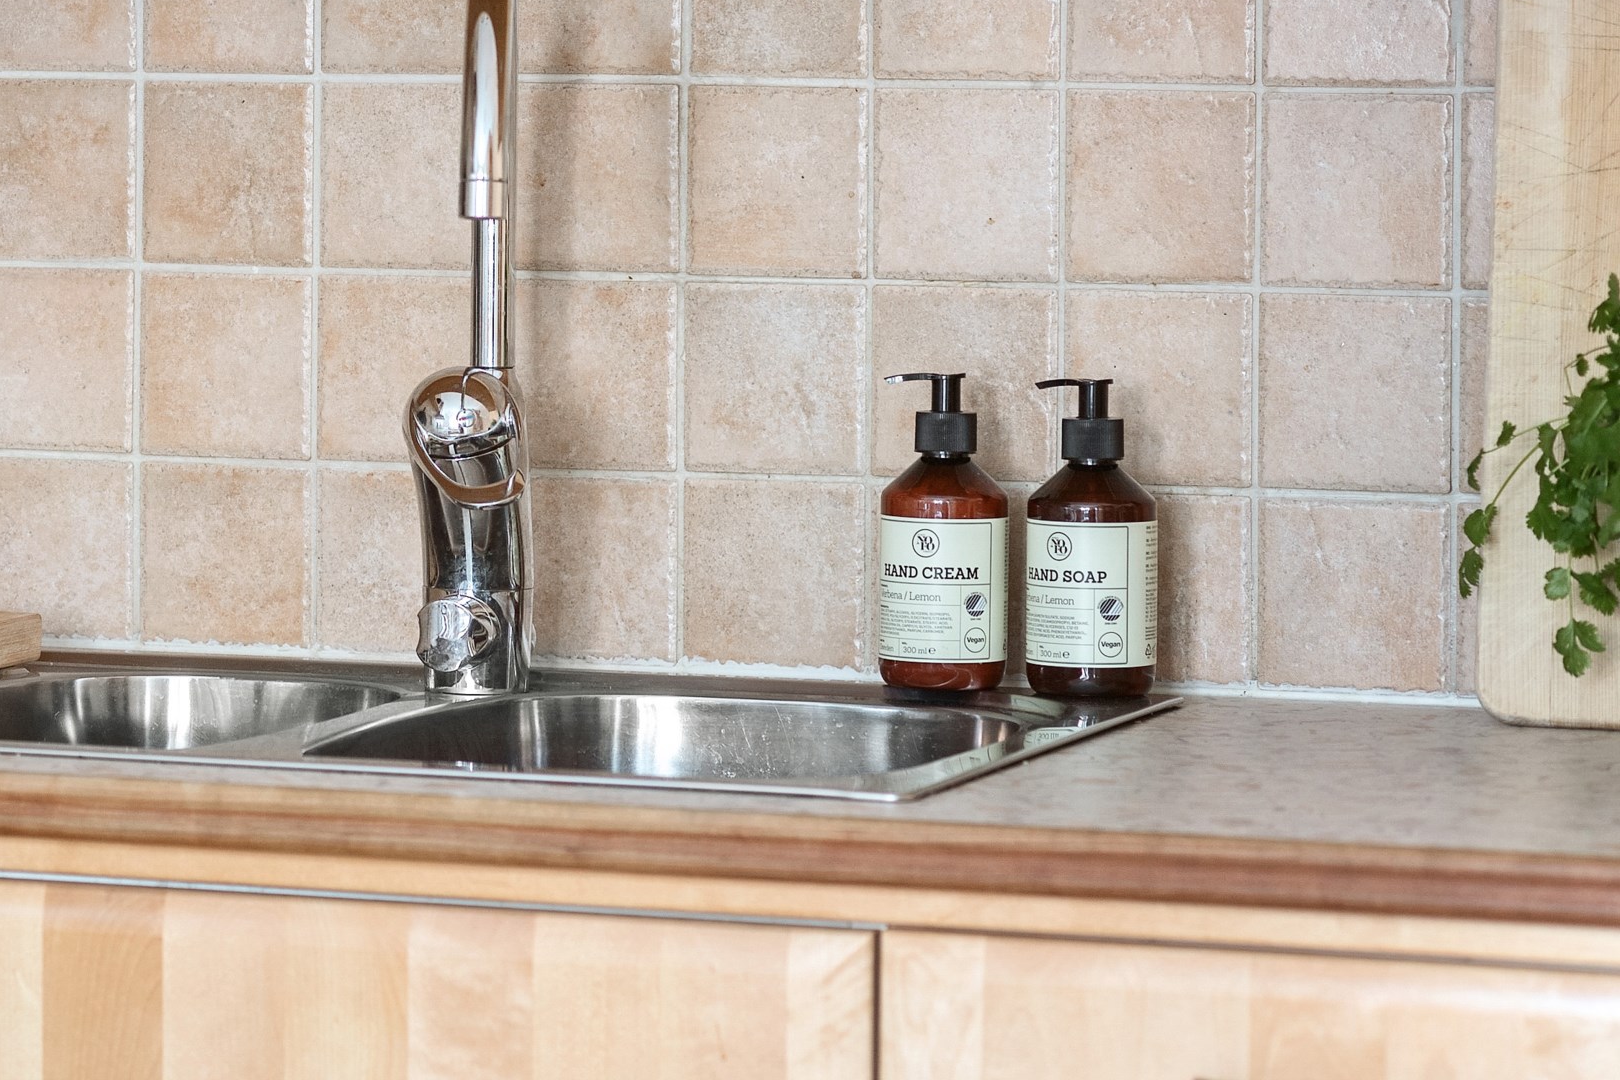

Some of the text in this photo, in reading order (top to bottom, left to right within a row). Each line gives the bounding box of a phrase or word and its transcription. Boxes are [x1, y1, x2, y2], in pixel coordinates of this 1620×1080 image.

[884, 563, 979, 580] HAND CREAM
[1028, 566, 1107, 583] HAND SOAP
[909, 592, 942, 602] Lemon
[1045, 594, 1075, 606] Lemon
[966, 636, 985, 644] Vegan
[1101, 641, 1121, 649] Vegan
[902, 646, 917, 654] 300
[918, 646, 928, 654] ml
[1040, 649, 1052, 658] 300
[1052, 650, 1062, 658] ml
